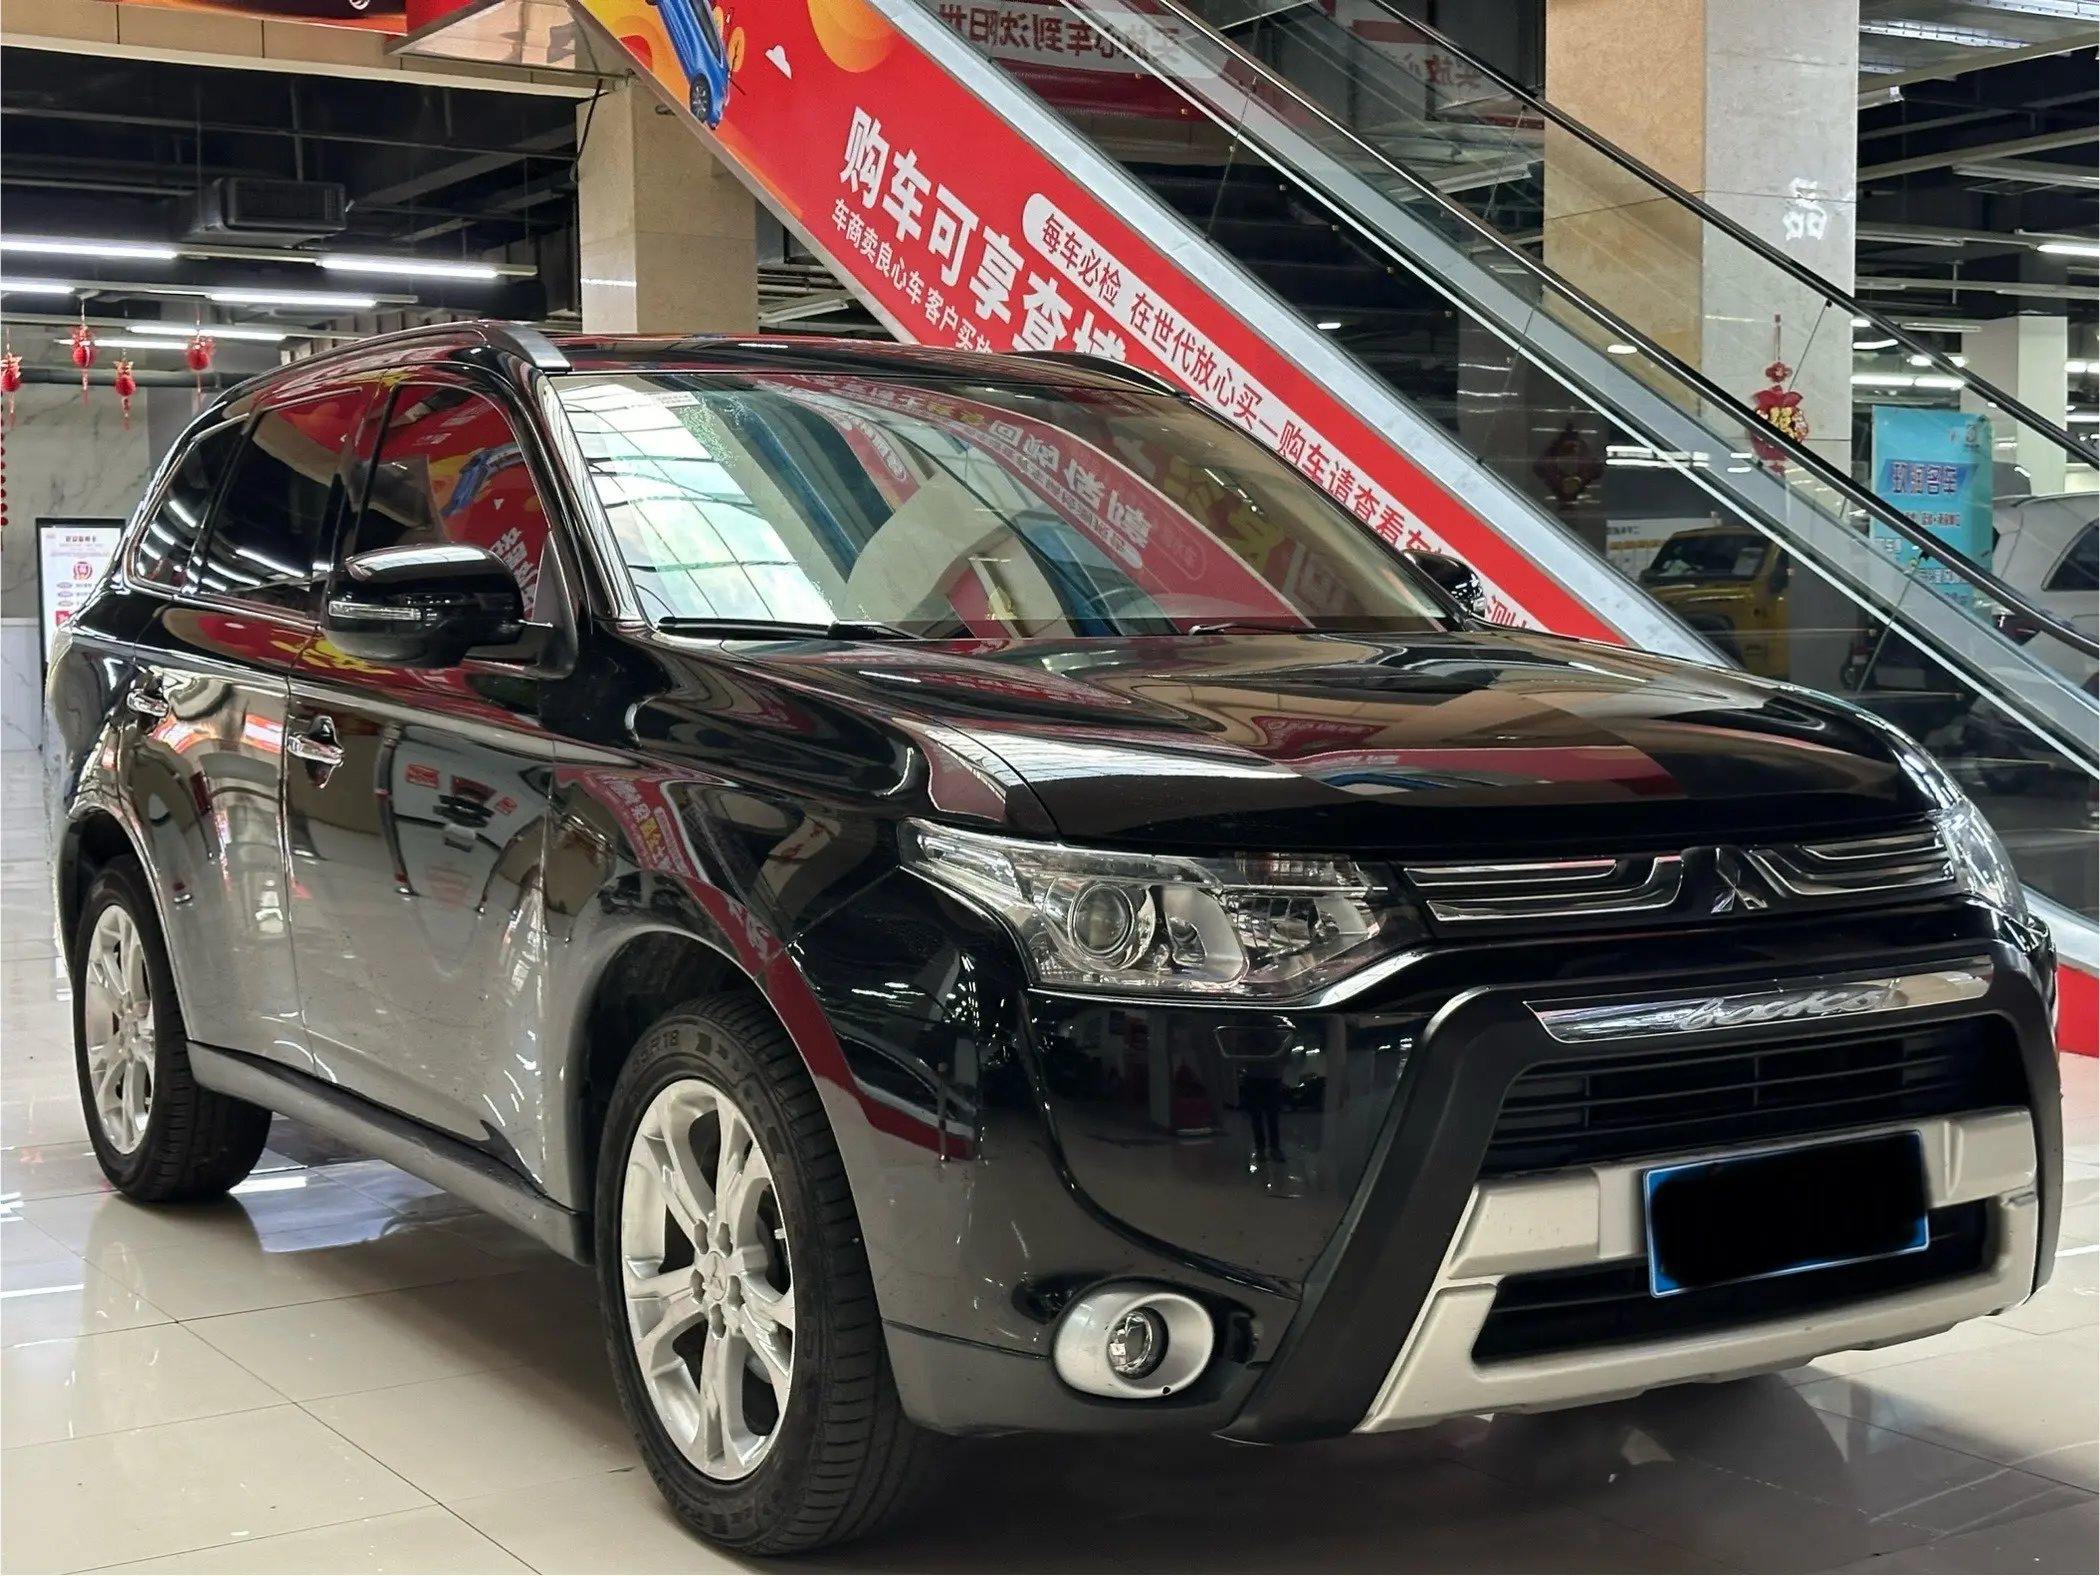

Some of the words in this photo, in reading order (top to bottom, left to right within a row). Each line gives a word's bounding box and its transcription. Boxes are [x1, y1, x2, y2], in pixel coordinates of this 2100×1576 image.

[831, 198, 925, 305] 车商卖良心车
[1041, 213, 1122, 308] 每车必检
